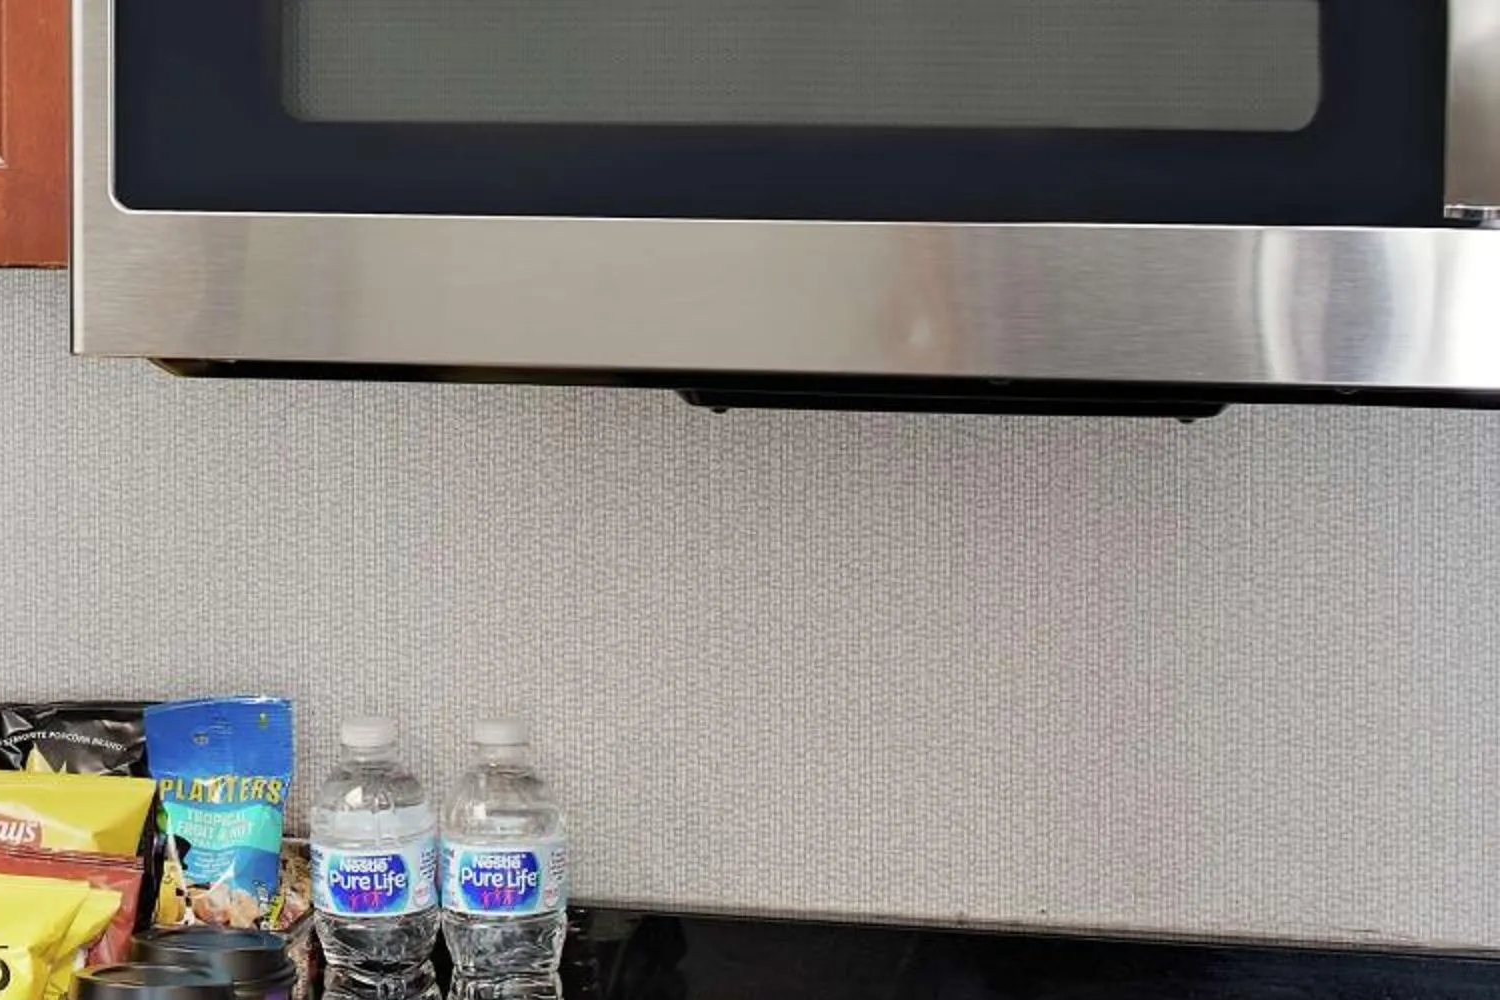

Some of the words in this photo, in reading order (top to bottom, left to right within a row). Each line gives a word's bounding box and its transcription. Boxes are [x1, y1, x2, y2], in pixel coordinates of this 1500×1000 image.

[329, 872, 371, 890] Pure
[374, 872, 407, 896] Life
[461, 867, 501, 887] Pure
[506, 869, 537, 895] Life
